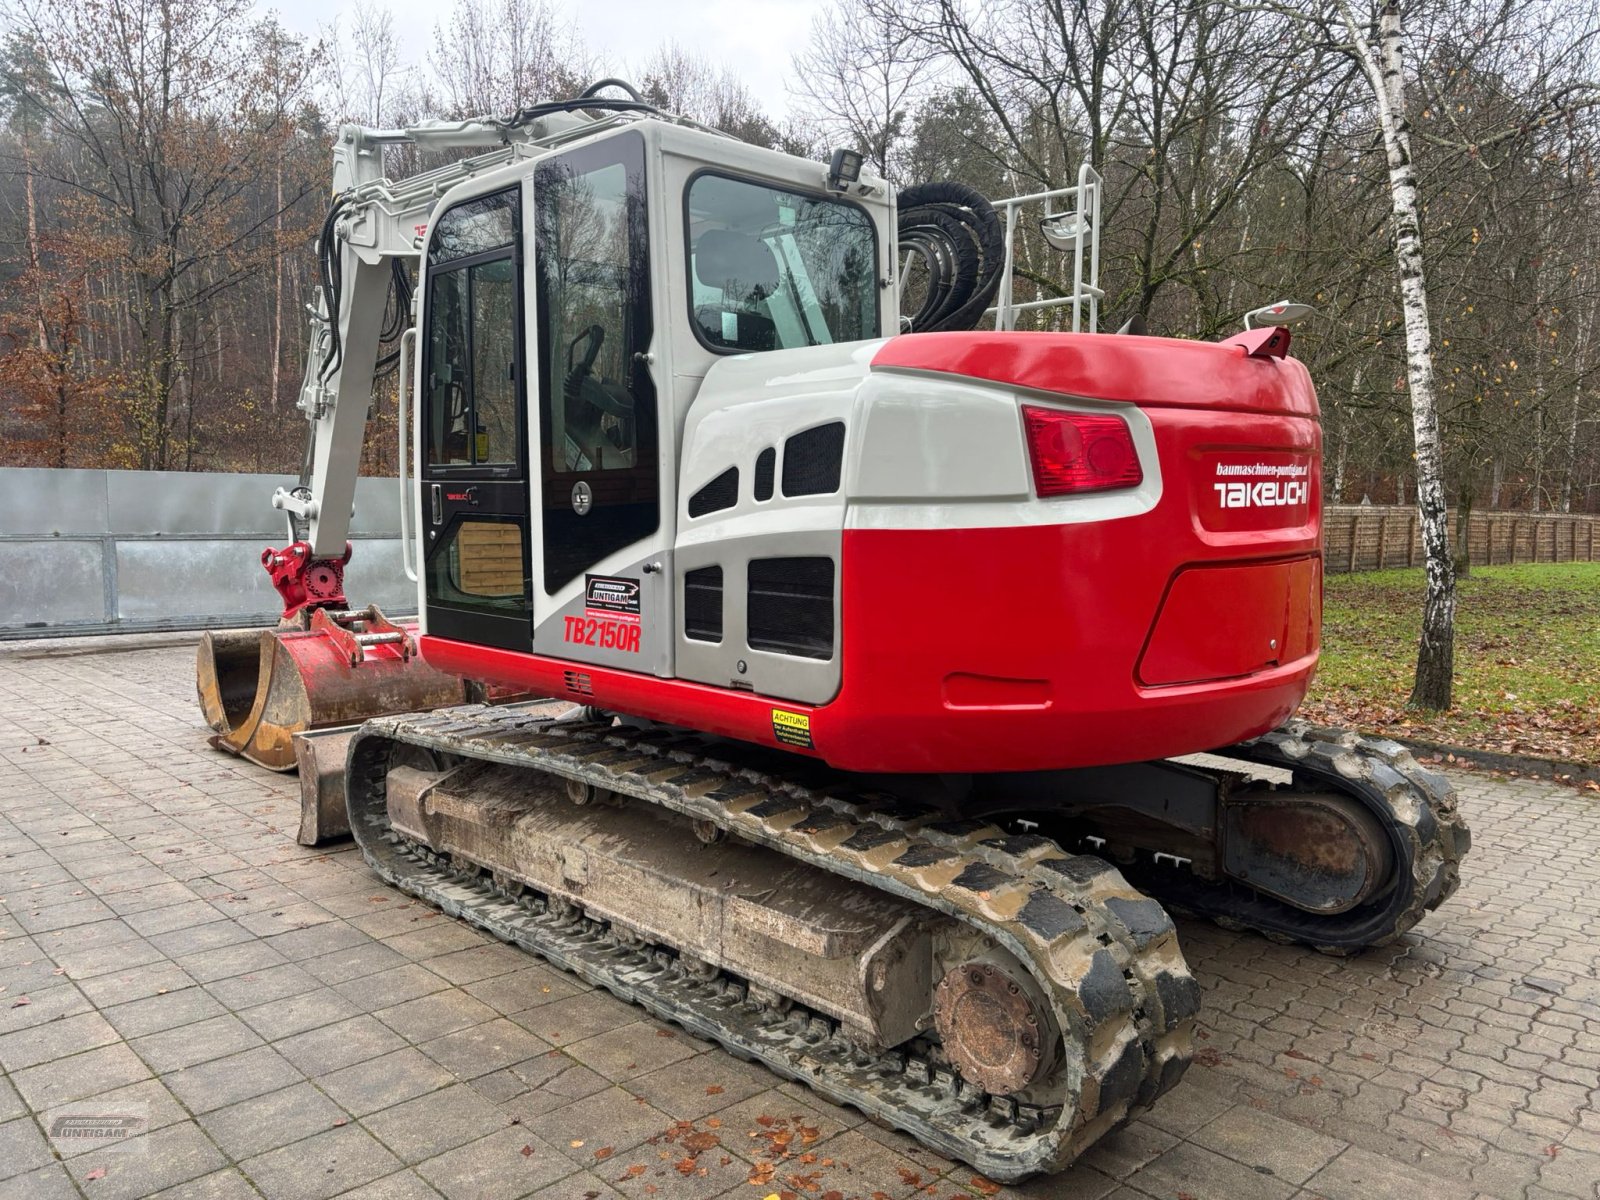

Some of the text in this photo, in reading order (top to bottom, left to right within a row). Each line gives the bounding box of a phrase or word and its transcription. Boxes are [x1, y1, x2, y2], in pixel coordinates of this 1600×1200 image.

[1214, 481, 1308, 508] TAKEUCHI
[563, 616, 642, 653] TB2150R
[774, 713, 808, 727] ACHTUNG
